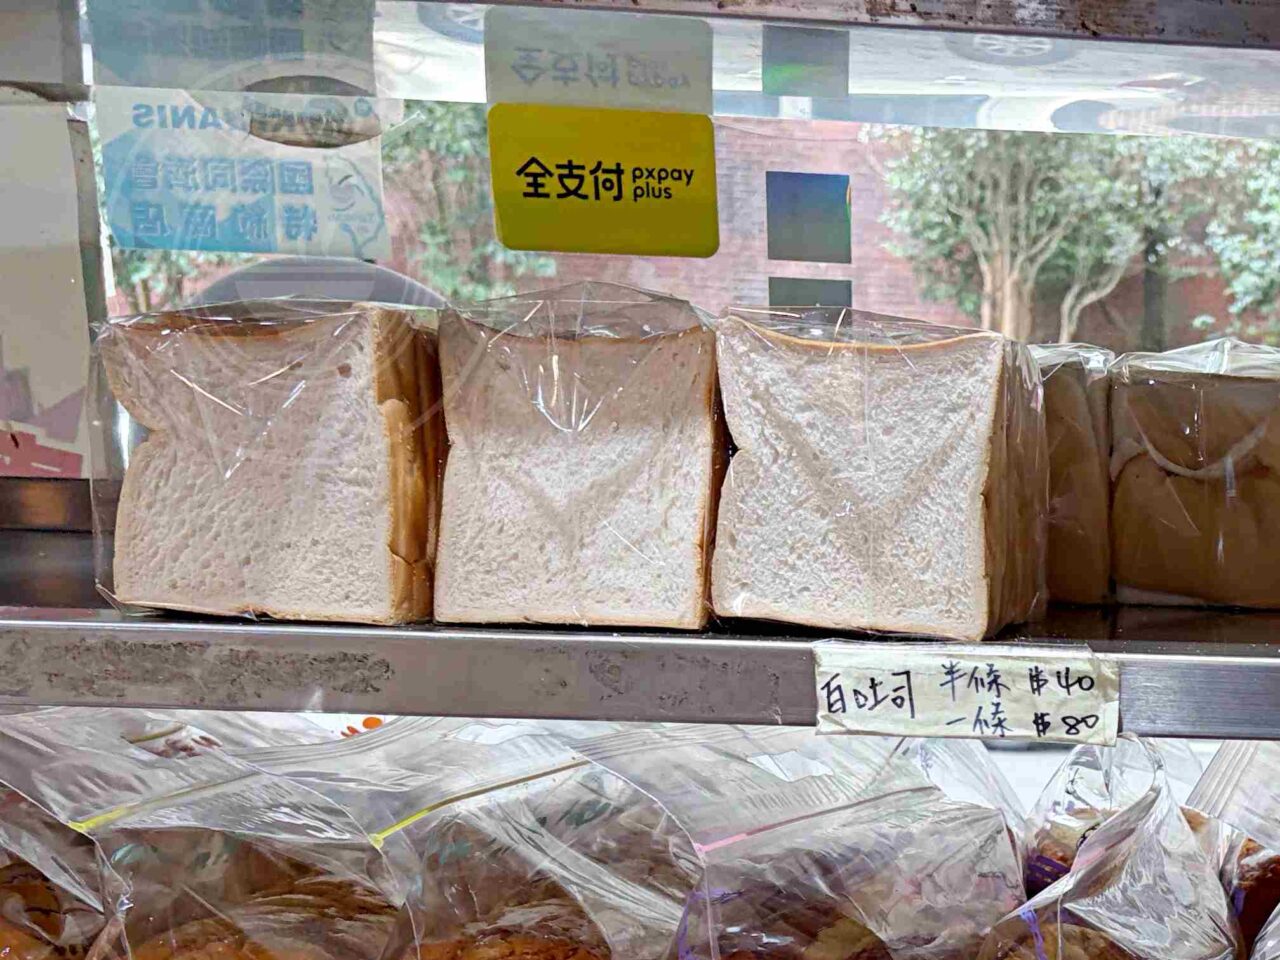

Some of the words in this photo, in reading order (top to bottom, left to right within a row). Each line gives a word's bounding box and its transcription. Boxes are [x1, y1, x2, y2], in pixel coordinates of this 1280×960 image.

[516, 156, 625, 201] 全支付
[632, 167, 695, 186] pxpay
[633, 184, 673, 202] plus
[820, 669, 916, 719] 白吐司
[938, 661, 1012, 701] 半條
[1028, 666, 1096, 697] $40
[946, 703, 1013, 737] 一條
[1033, 712, 1100, 737] $80
